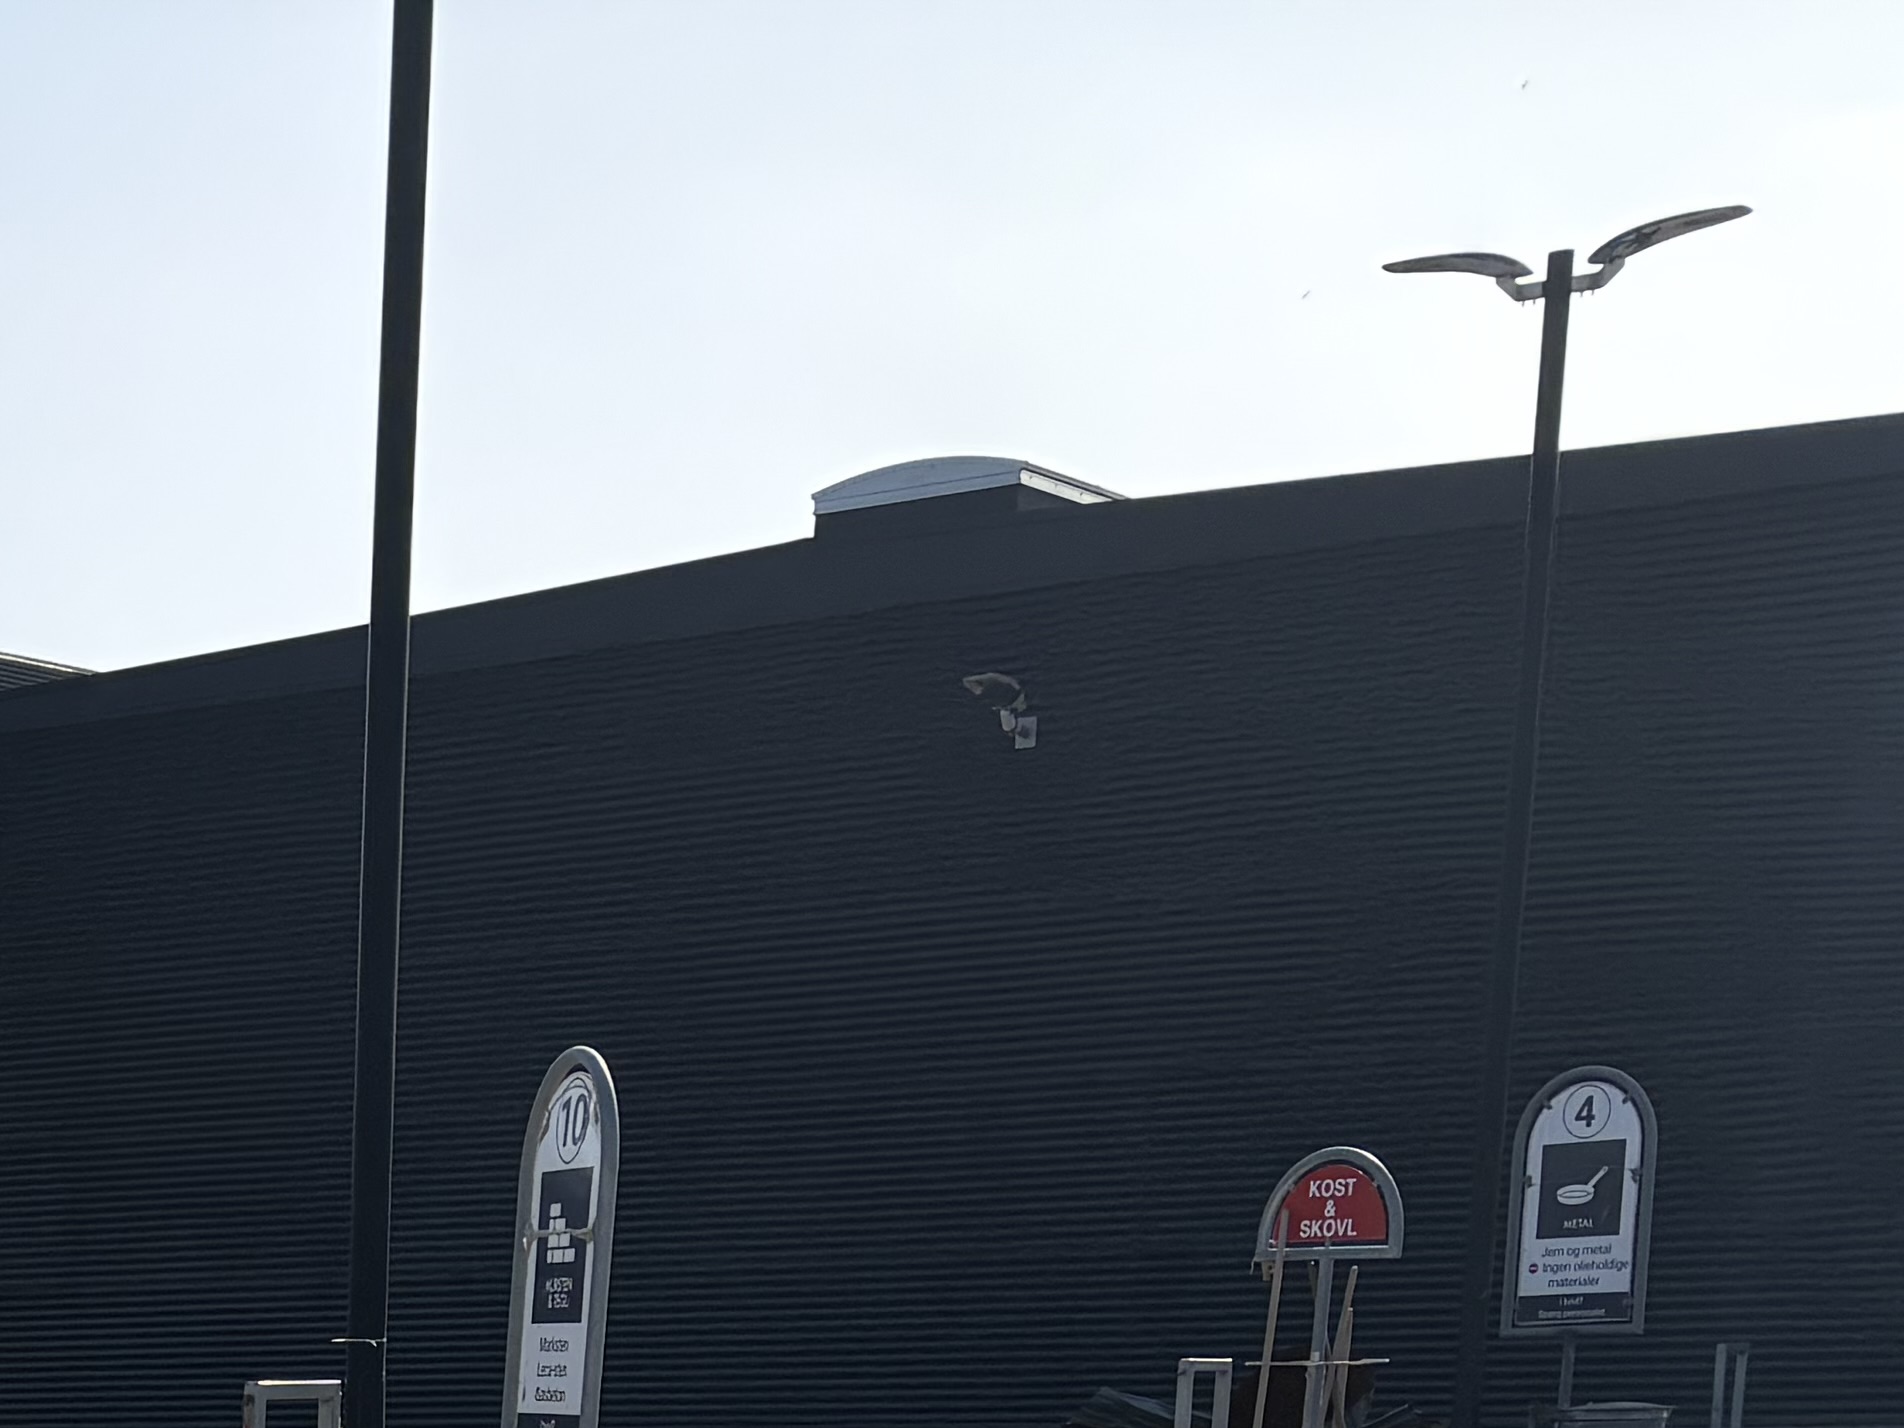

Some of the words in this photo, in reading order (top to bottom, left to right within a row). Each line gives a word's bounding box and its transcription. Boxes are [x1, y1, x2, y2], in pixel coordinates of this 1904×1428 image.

[561, 1093, 590, 1148] 10
[1574, 1094, 1596, 1128] 4
[1309, 1178, 1357, 1198] KOST
[1324, 1200, 1336, 1217] &
[1299, 1218, 1357, 1239] SKOVL
[1563, 1218, 1594, 1229] METAL
[1566, 1247, 1580, 1259] og
[1582, 1242, 1612, 1255] metal
